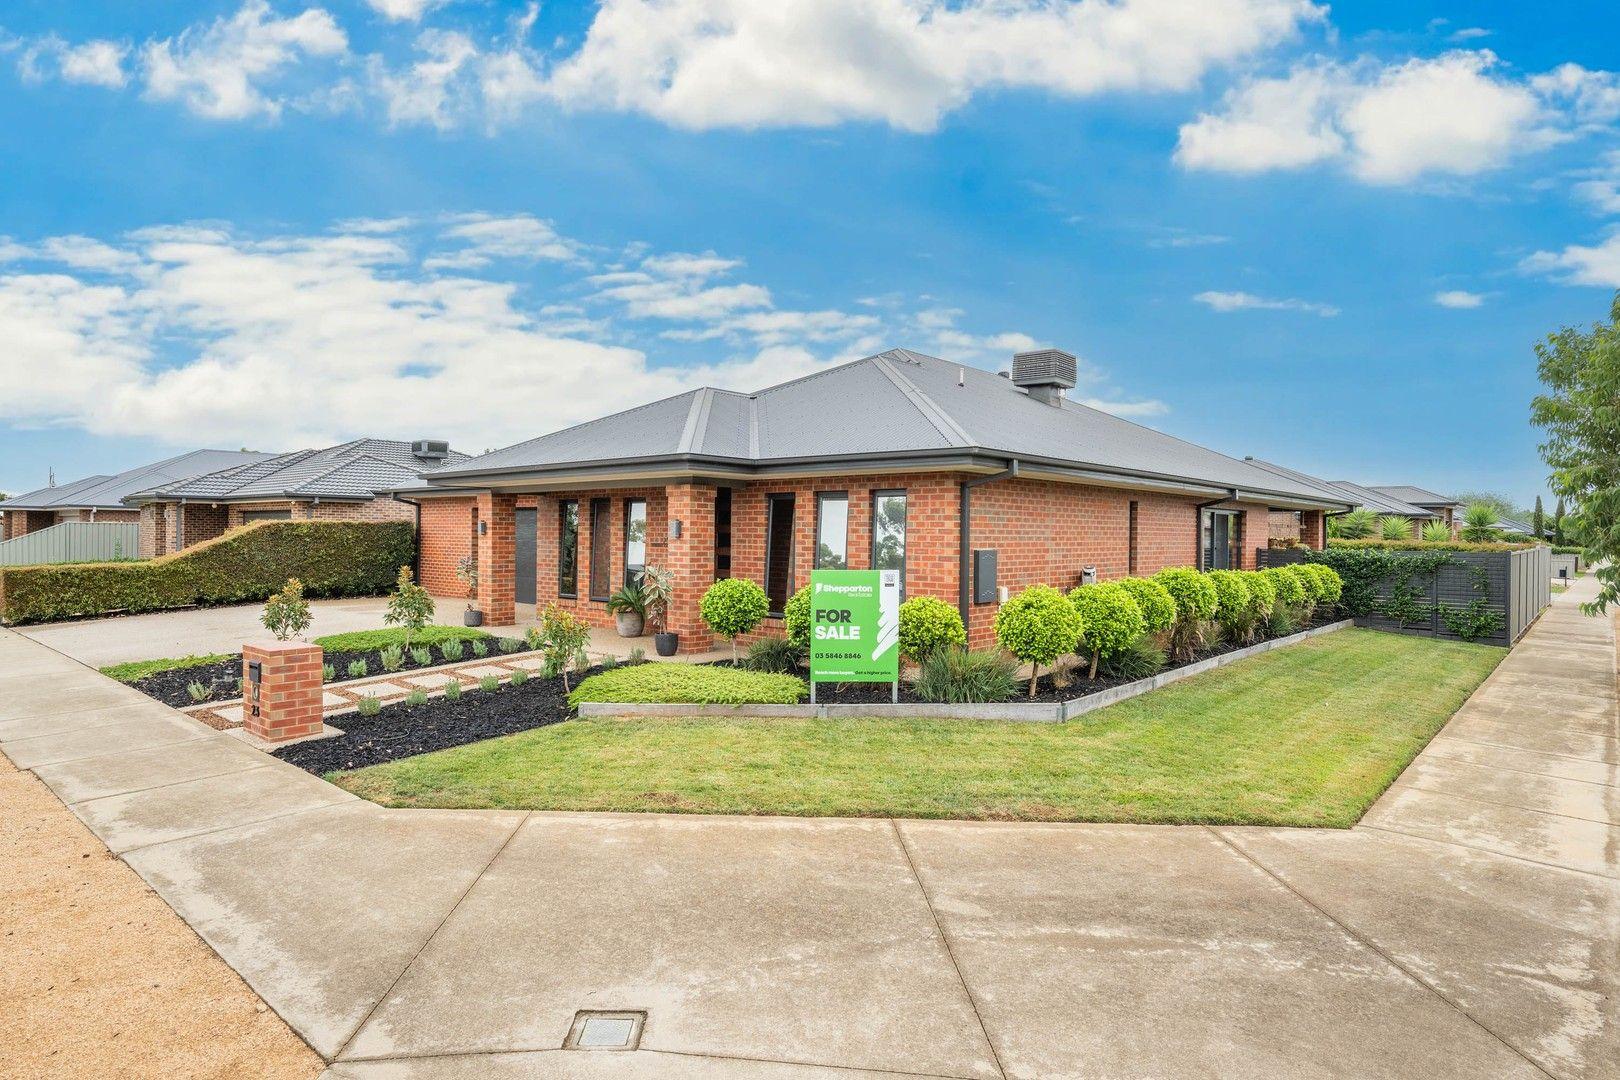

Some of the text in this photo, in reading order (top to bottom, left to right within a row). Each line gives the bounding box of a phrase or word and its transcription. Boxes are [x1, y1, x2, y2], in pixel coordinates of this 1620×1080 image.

[823, 584, 872, 593] Shepparton
[816, 609, 851, 623] FOR
[815, 626, 860, 640] SALE
